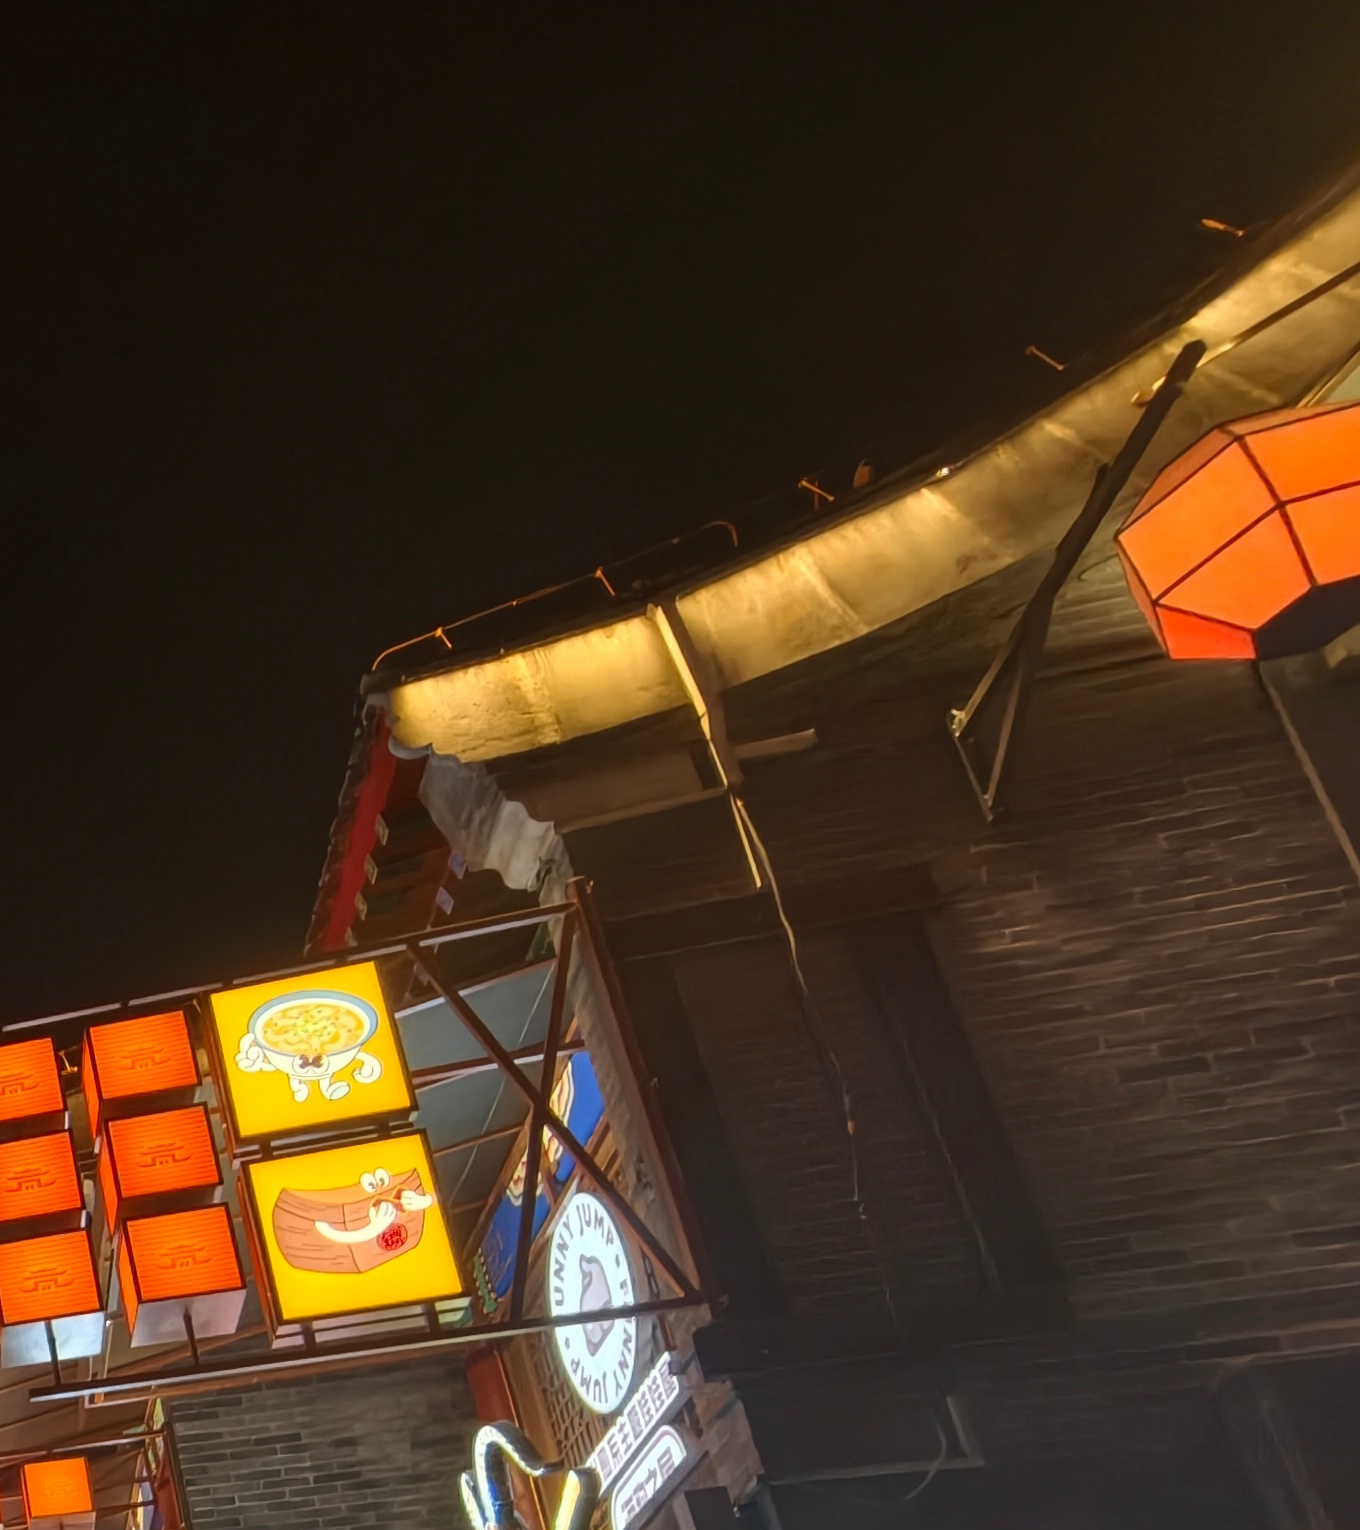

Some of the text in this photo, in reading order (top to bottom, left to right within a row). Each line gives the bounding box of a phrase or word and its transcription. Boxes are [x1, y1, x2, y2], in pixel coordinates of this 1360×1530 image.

[577, 1202, 615, 1247] JUMP
[571, 1278, 634, 1404] FNNY JUMP
